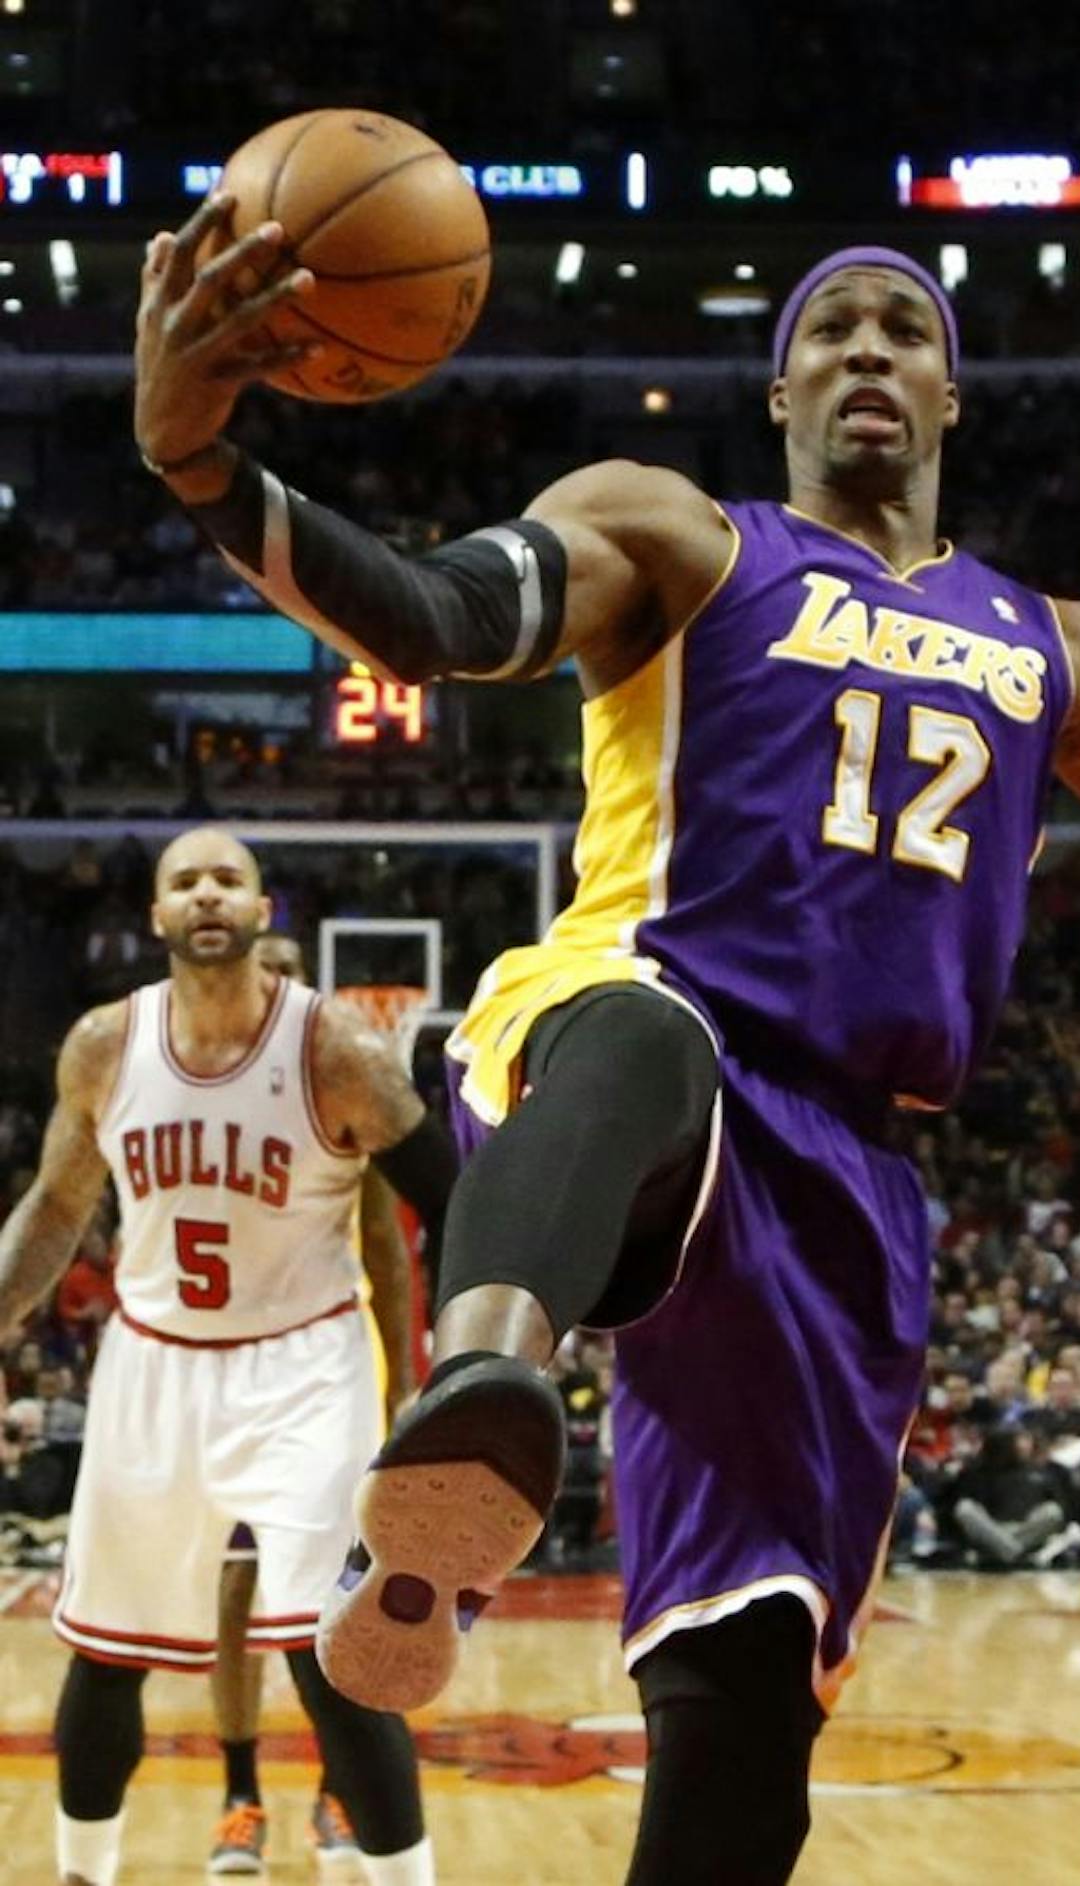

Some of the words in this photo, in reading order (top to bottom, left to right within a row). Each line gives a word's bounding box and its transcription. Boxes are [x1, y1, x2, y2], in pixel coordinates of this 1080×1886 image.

[482, 166, 581, 194] CLUB
[766, 571, 1048, 722] LAKERS
[337, 677, 421, 741] 24
[821, 688, 991, 884] 12
[123, 1119, 293, 1209] BULLS
[174, 1217, 231, 1311] 5
